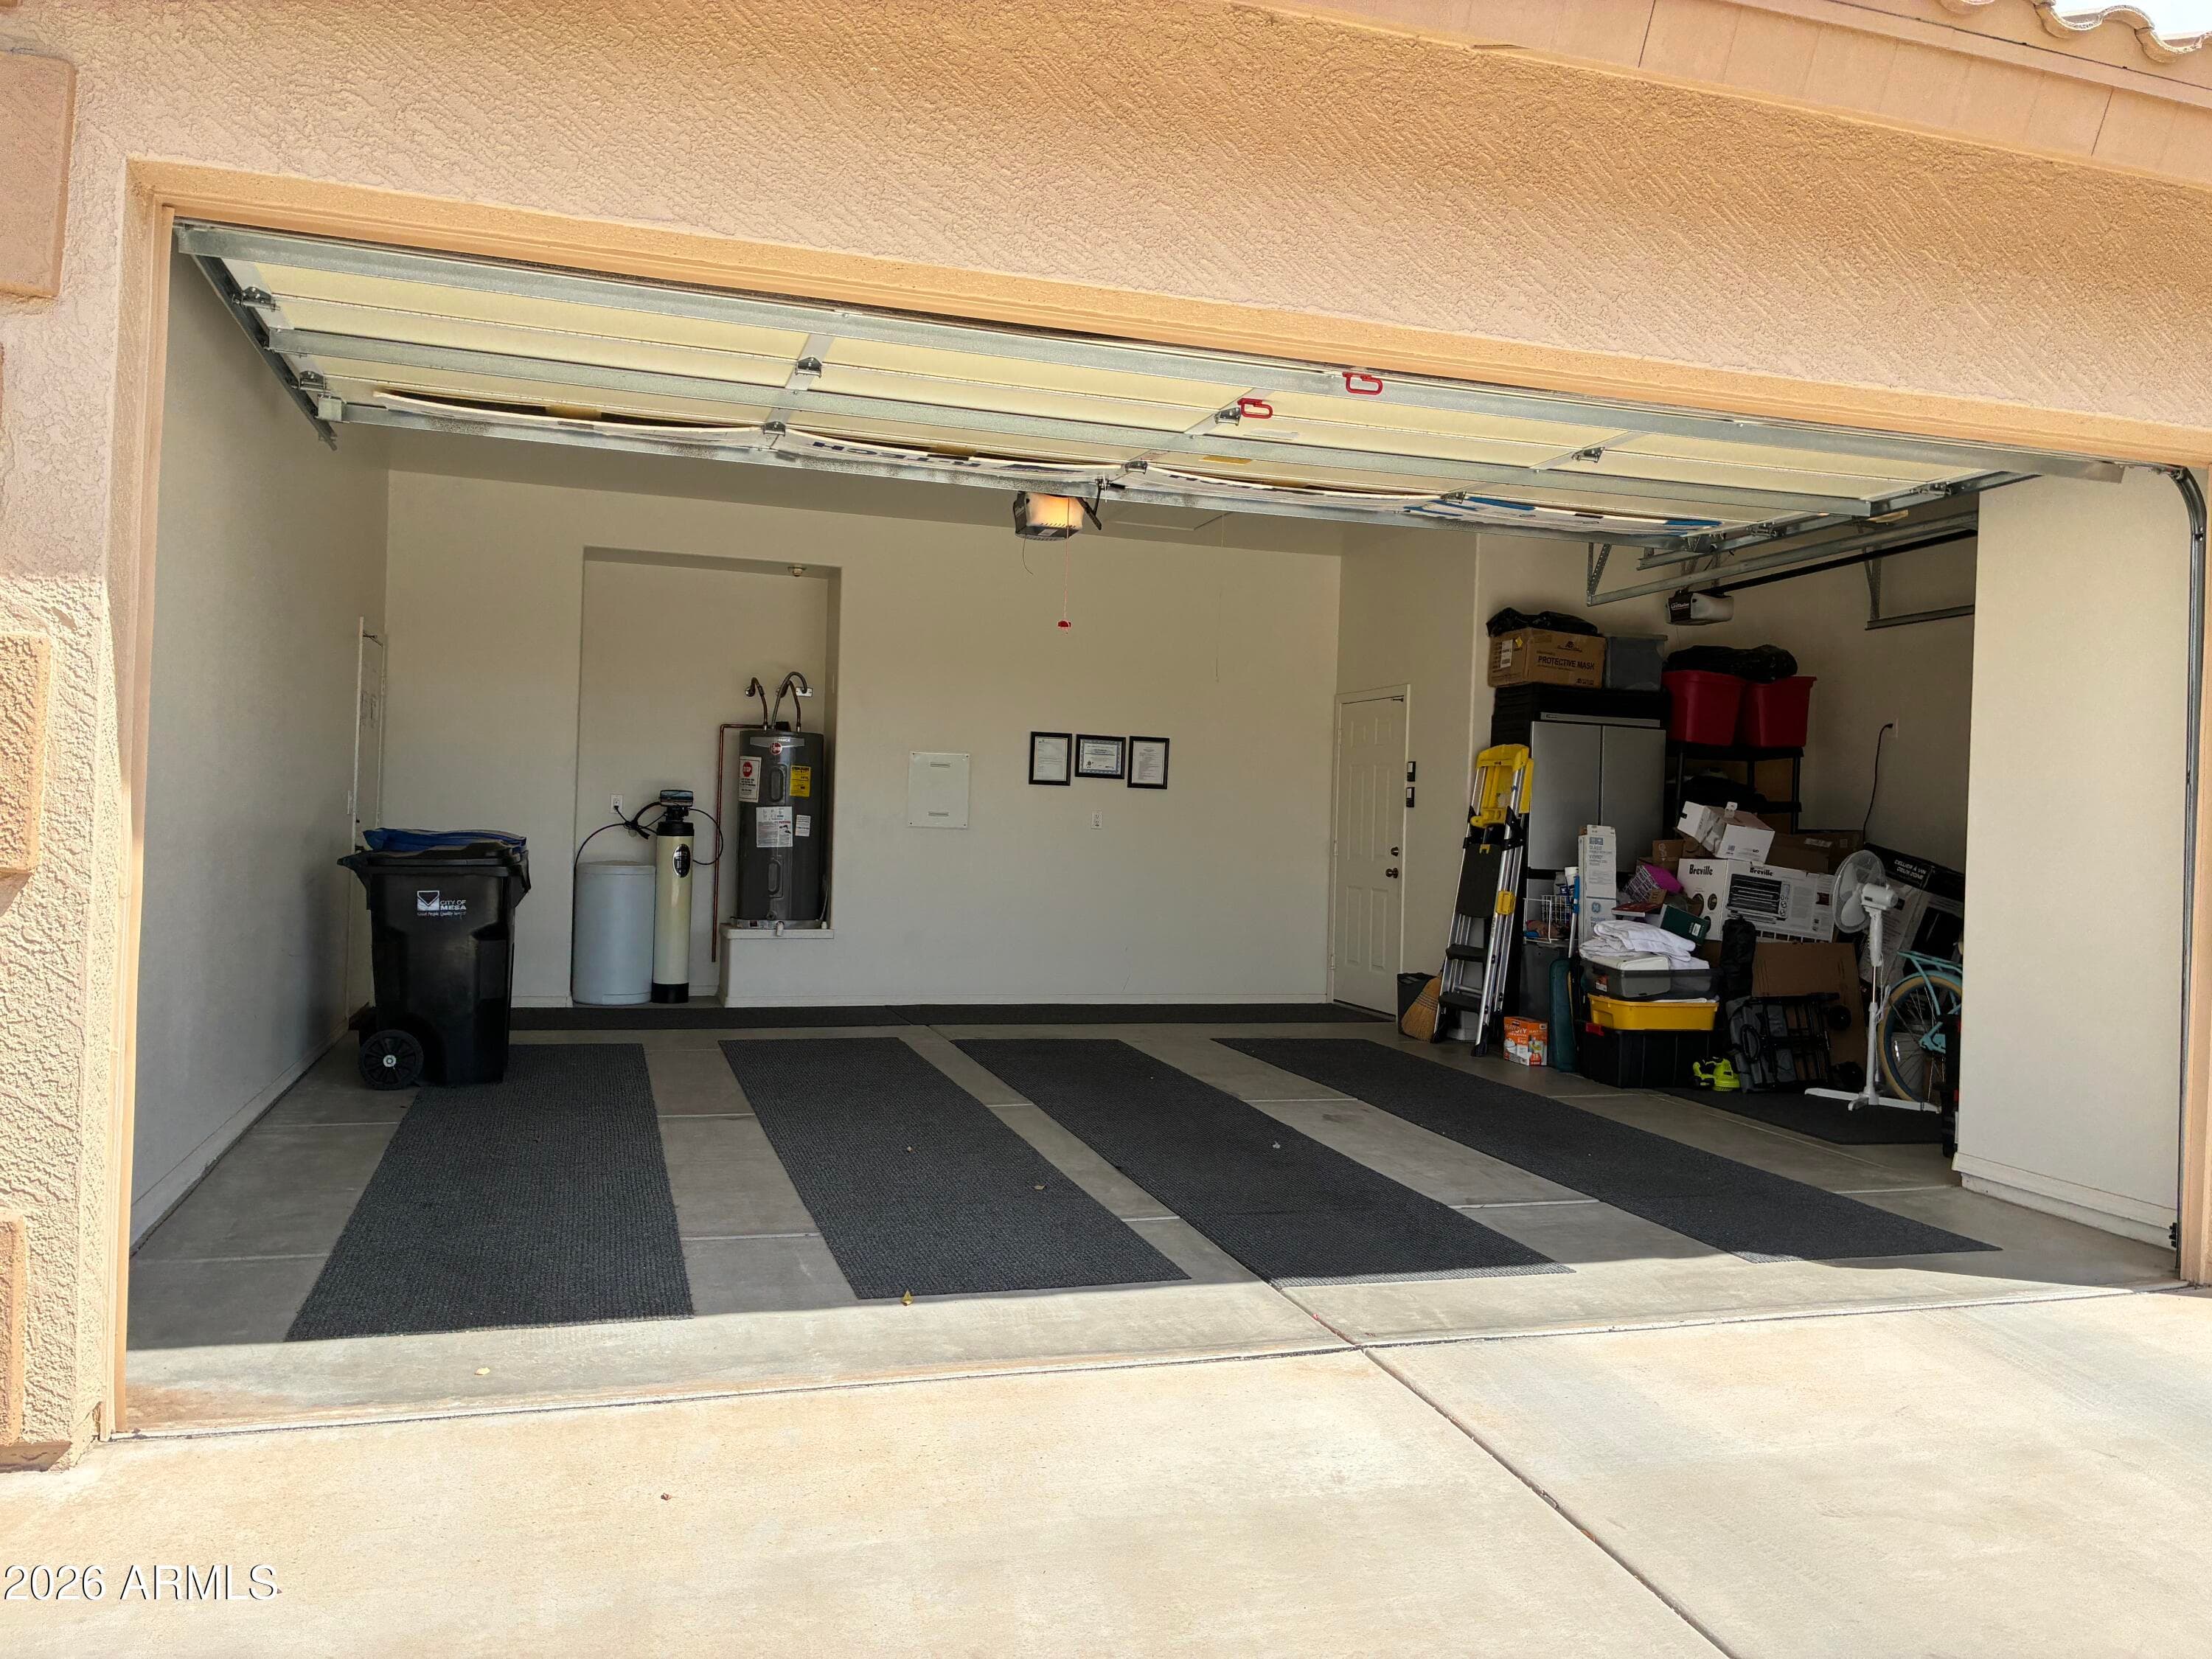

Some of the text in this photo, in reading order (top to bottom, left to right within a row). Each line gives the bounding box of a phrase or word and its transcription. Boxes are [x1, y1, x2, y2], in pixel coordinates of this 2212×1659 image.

[1538, 655, 1576, 668] PROTECTIVE
[1576, 661, 1596, 670] MASK
[1688, 863, 1714, 876] Breville
[1750, 867, 1773, 877] Breville
